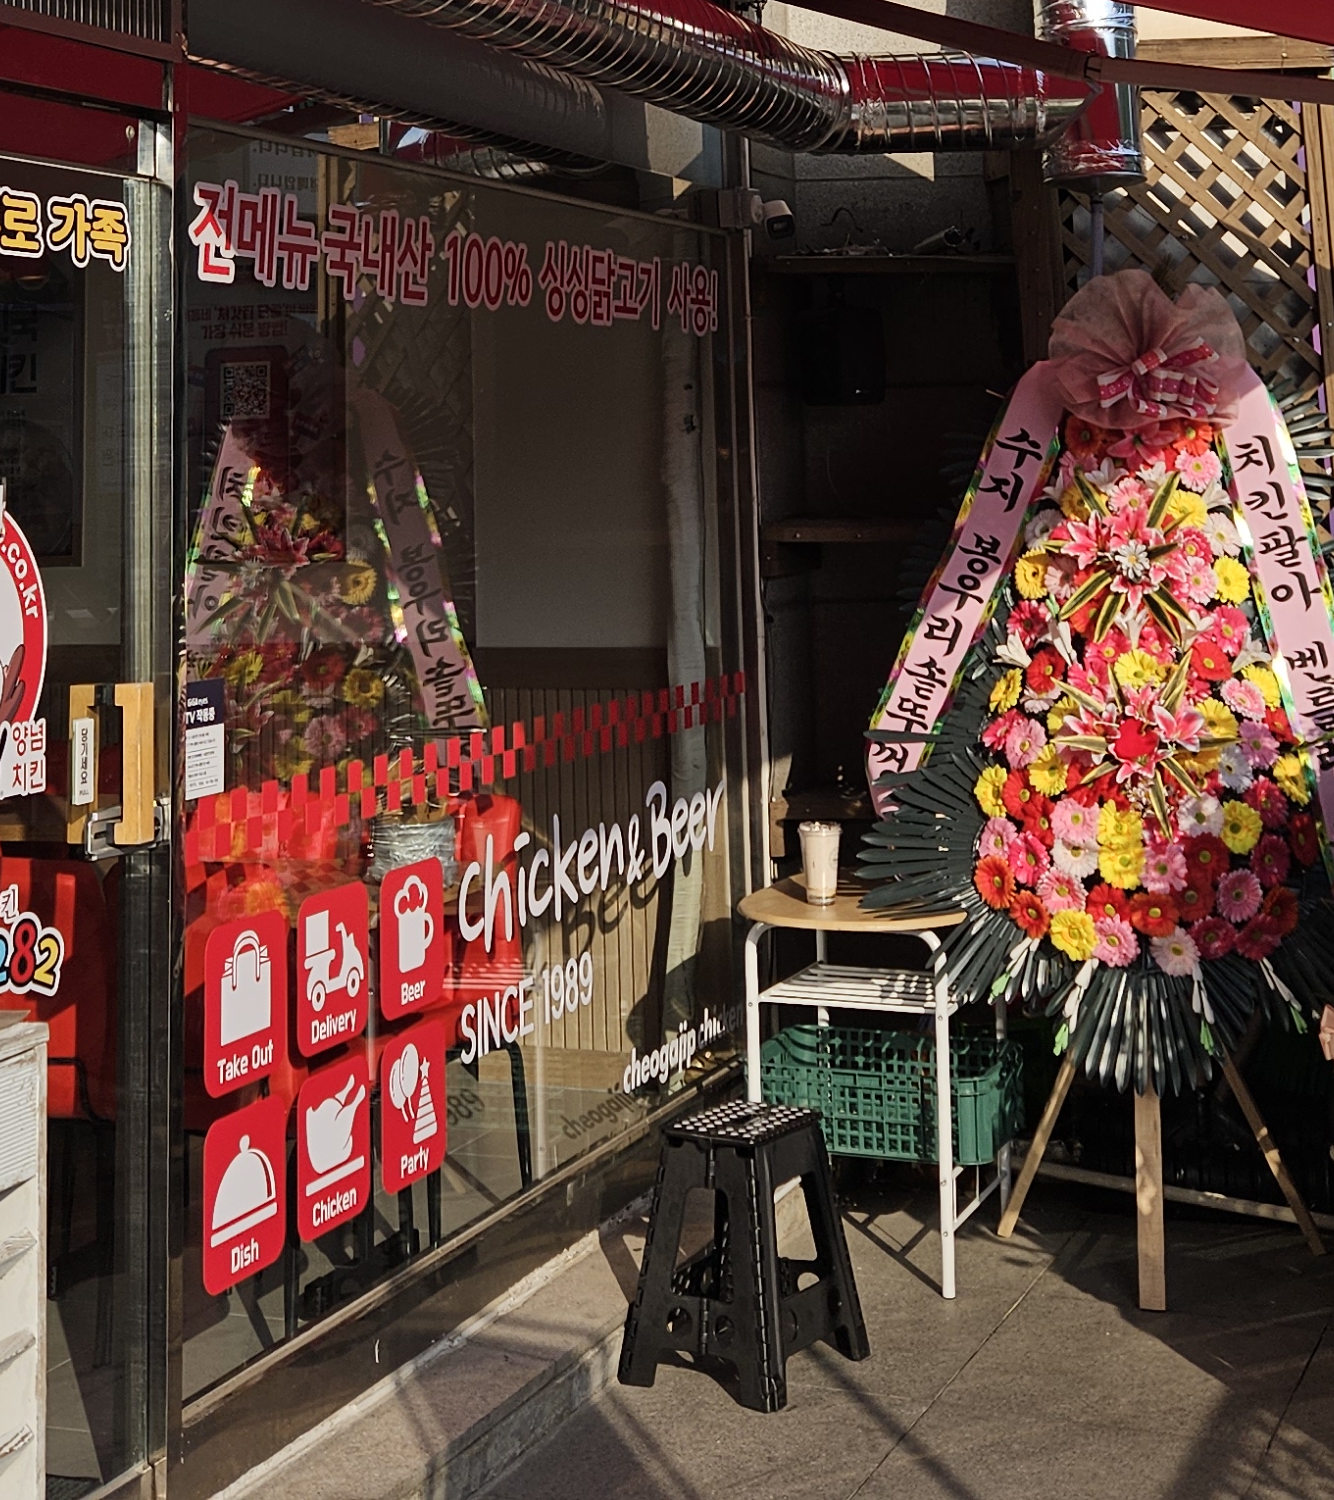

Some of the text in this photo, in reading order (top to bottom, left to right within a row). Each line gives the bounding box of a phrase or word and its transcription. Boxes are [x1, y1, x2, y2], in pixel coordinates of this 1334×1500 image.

[47, 193, 132, 273] 가족
[321, 203, 436, 306] 국내산
[442, 229, 534, 313] 100%
[538, 239, 663, 331] 싱싱닭고기
[667, 259, 719, 338] 사용!
[978, 426, 1044, 514] 수지
[1233, 434, 1323, 612] 치킨팔아
[12, 718, 45, 754] 양념
[80, 727, 89, 785] 당기세요
[12, 761, 45, 792] 치킨
[400, 979, 426, 1006] Beer
[460, 950, 594, 1065] SINCE 1989
[310, 1008, 357, 1045] Delivery
[216, 1038, 274, 1085] Take Out
[623, 1018, 697, 1095] cheogajip
[399, 1145, 430, 1180] Party
[311, 1187, 358, 1227] Chicken
[230, 1242, 260, 1275] Dish
